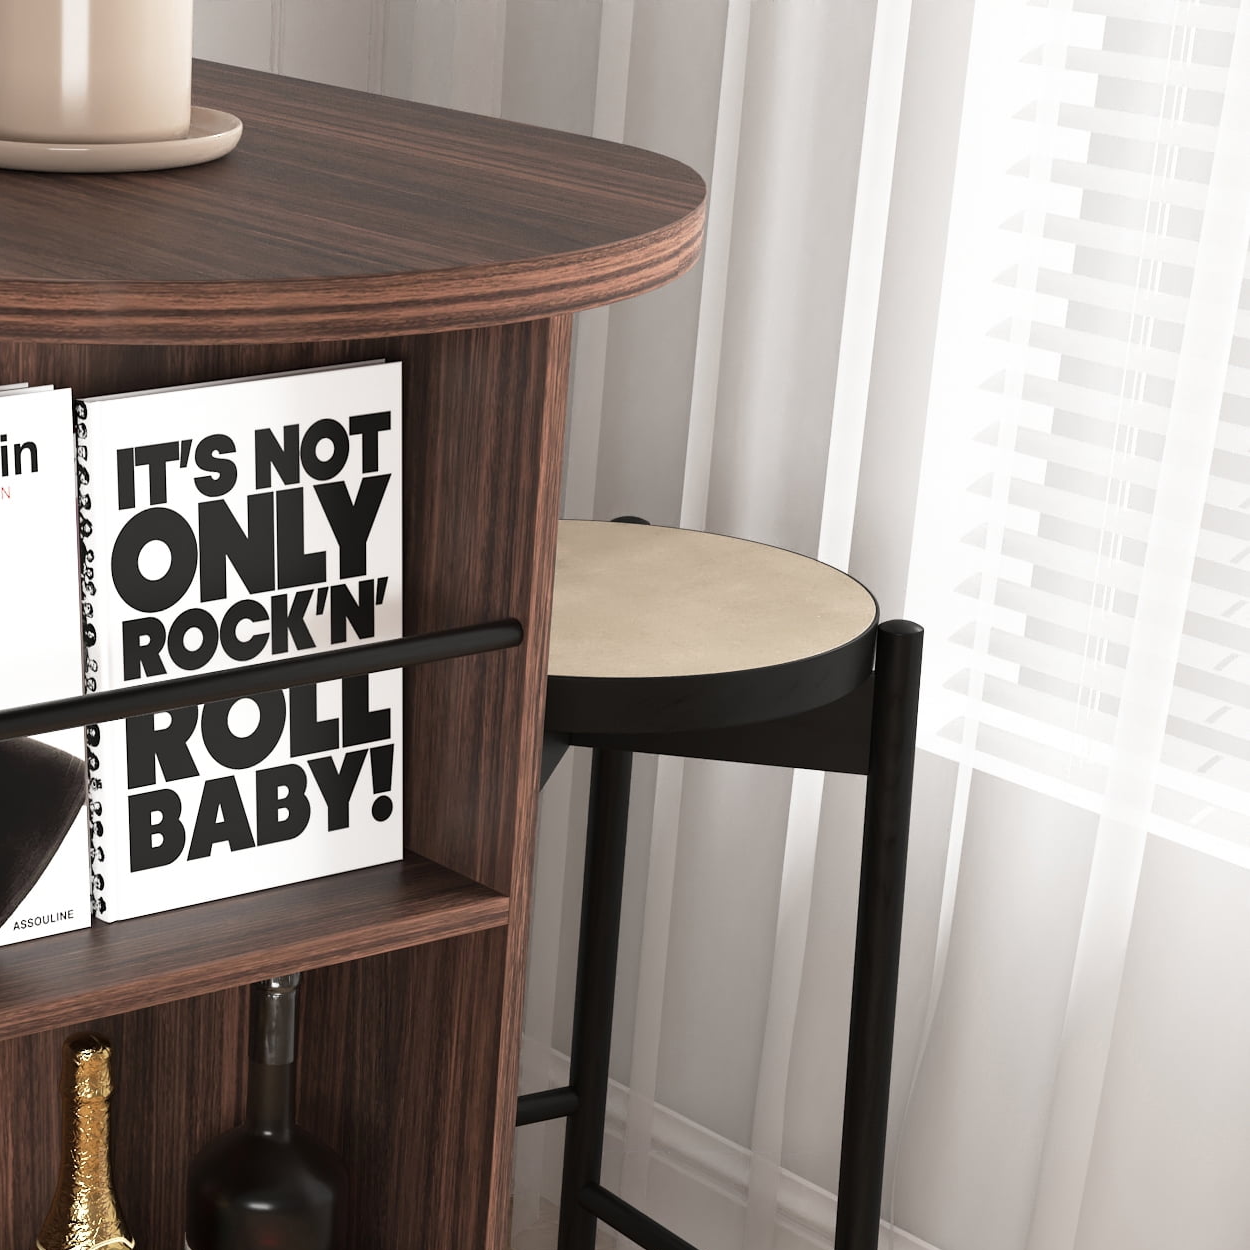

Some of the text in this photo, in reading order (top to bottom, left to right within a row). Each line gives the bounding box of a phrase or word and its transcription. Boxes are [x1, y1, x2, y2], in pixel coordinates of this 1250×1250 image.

[116, 410, 392, 511] IT'S NOT
[111, 473, 392, 614] ONLY
[125, 677, 392, 790] ROLL
[128, 743, 395, 873] BABY!
[12, 909, 75, 932] ASSOULINE
